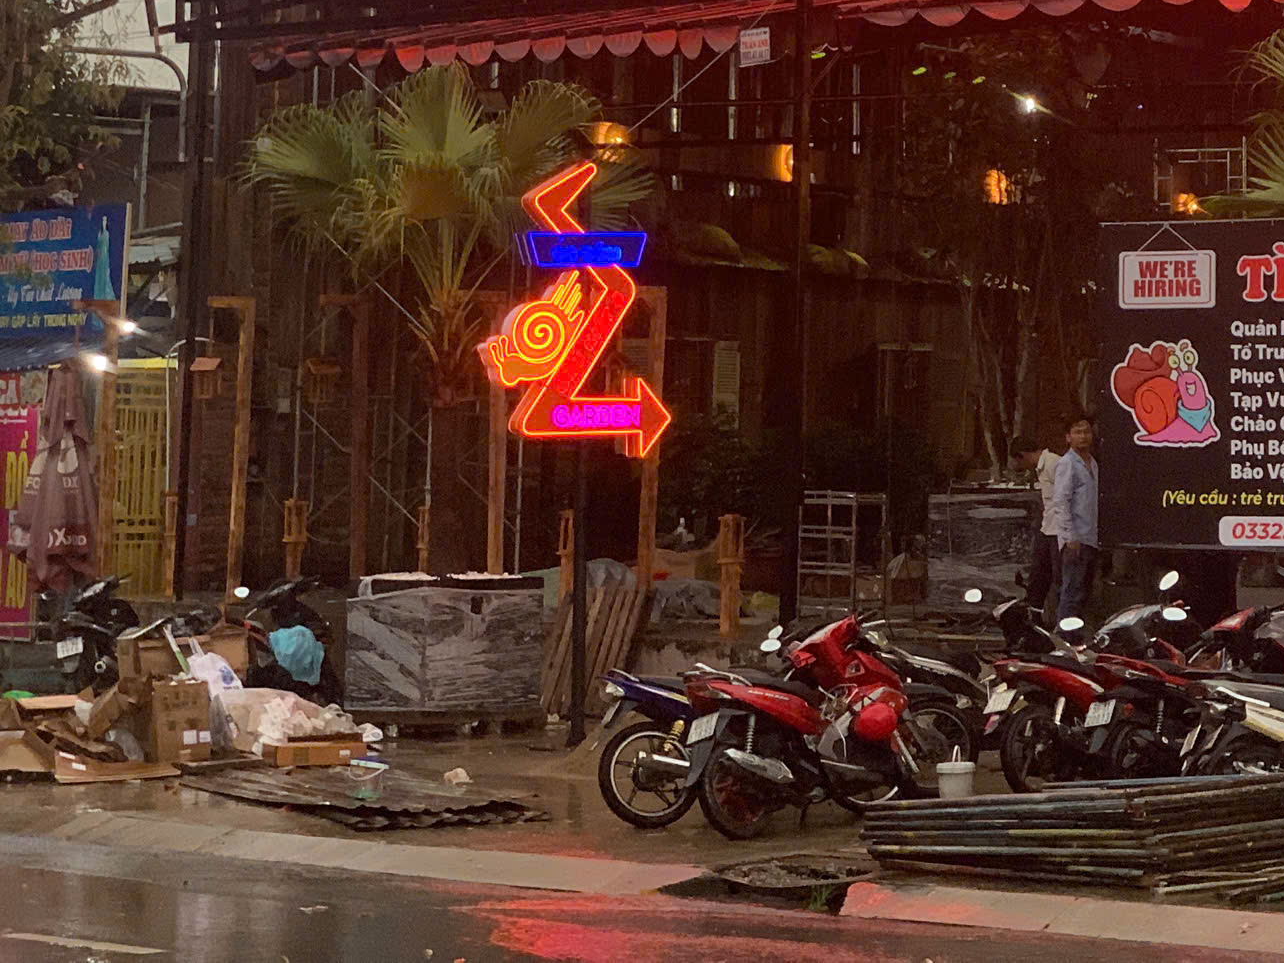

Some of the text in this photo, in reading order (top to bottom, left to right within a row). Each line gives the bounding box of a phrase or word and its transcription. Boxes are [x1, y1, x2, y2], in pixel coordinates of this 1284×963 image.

[1138, 260, 1197, 279] WE'RE
[1133, 278, 1202, 298] HIRING
[1230, 319, 1277, 337] Quản
[1230, 343, 1253, 361] Tổ
[1230, 368, 1275, 387] Phục
[1230, 391, 1263, 412] Tạp
[551, 404, 641, 429] GARDEN
[1230, 414, 1277, 432] Chảo
[1230, 439, 1264, 459] Phụ
[1230, 461, 1264, 480] Bảo
[1162, 489, 1195, 508] (Yêu
[1199, 489, 1228, 505] cầu
[1240, 489, 1263, 505] trẻ
